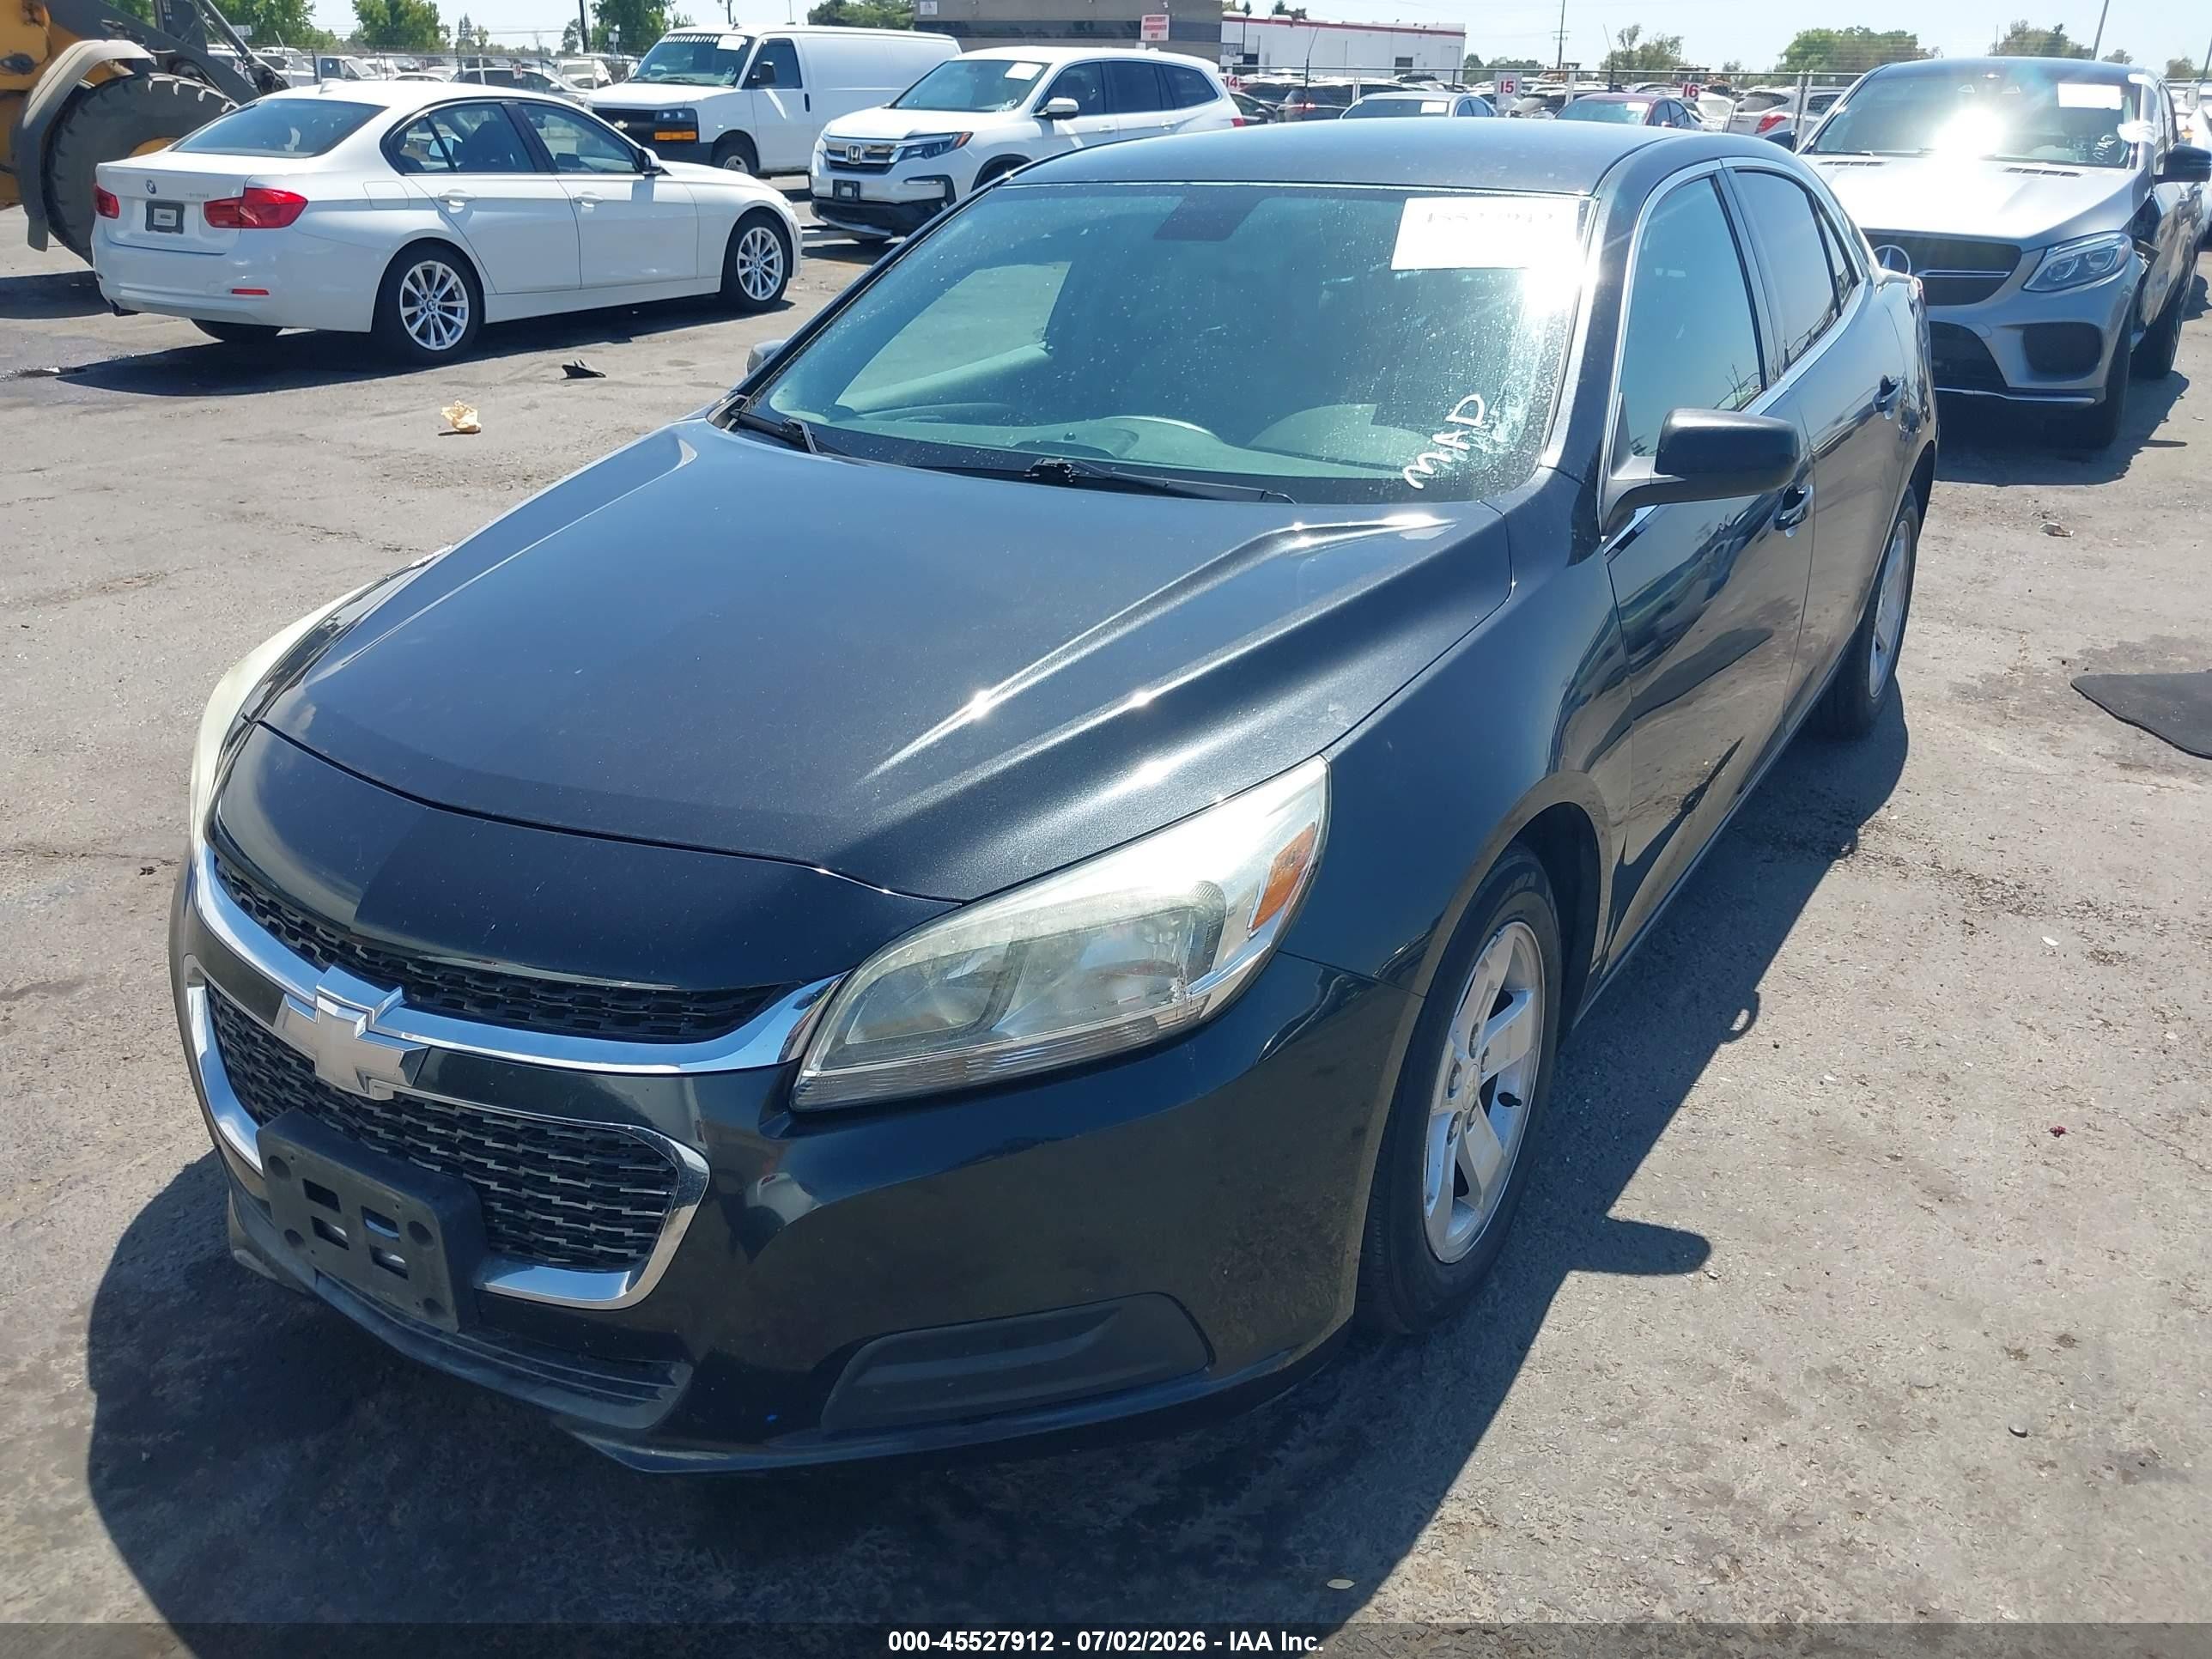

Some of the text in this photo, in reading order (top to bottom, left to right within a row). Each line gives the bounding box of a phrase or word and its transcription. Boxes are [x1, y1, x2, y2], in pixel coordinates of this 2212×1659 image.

[1225, 76, 1238, 88] 14
[1499, 81, 1515, 94] 15
[1682, 83, 1699, 98] 16
[1402, 393, 1486, 490] MAD
